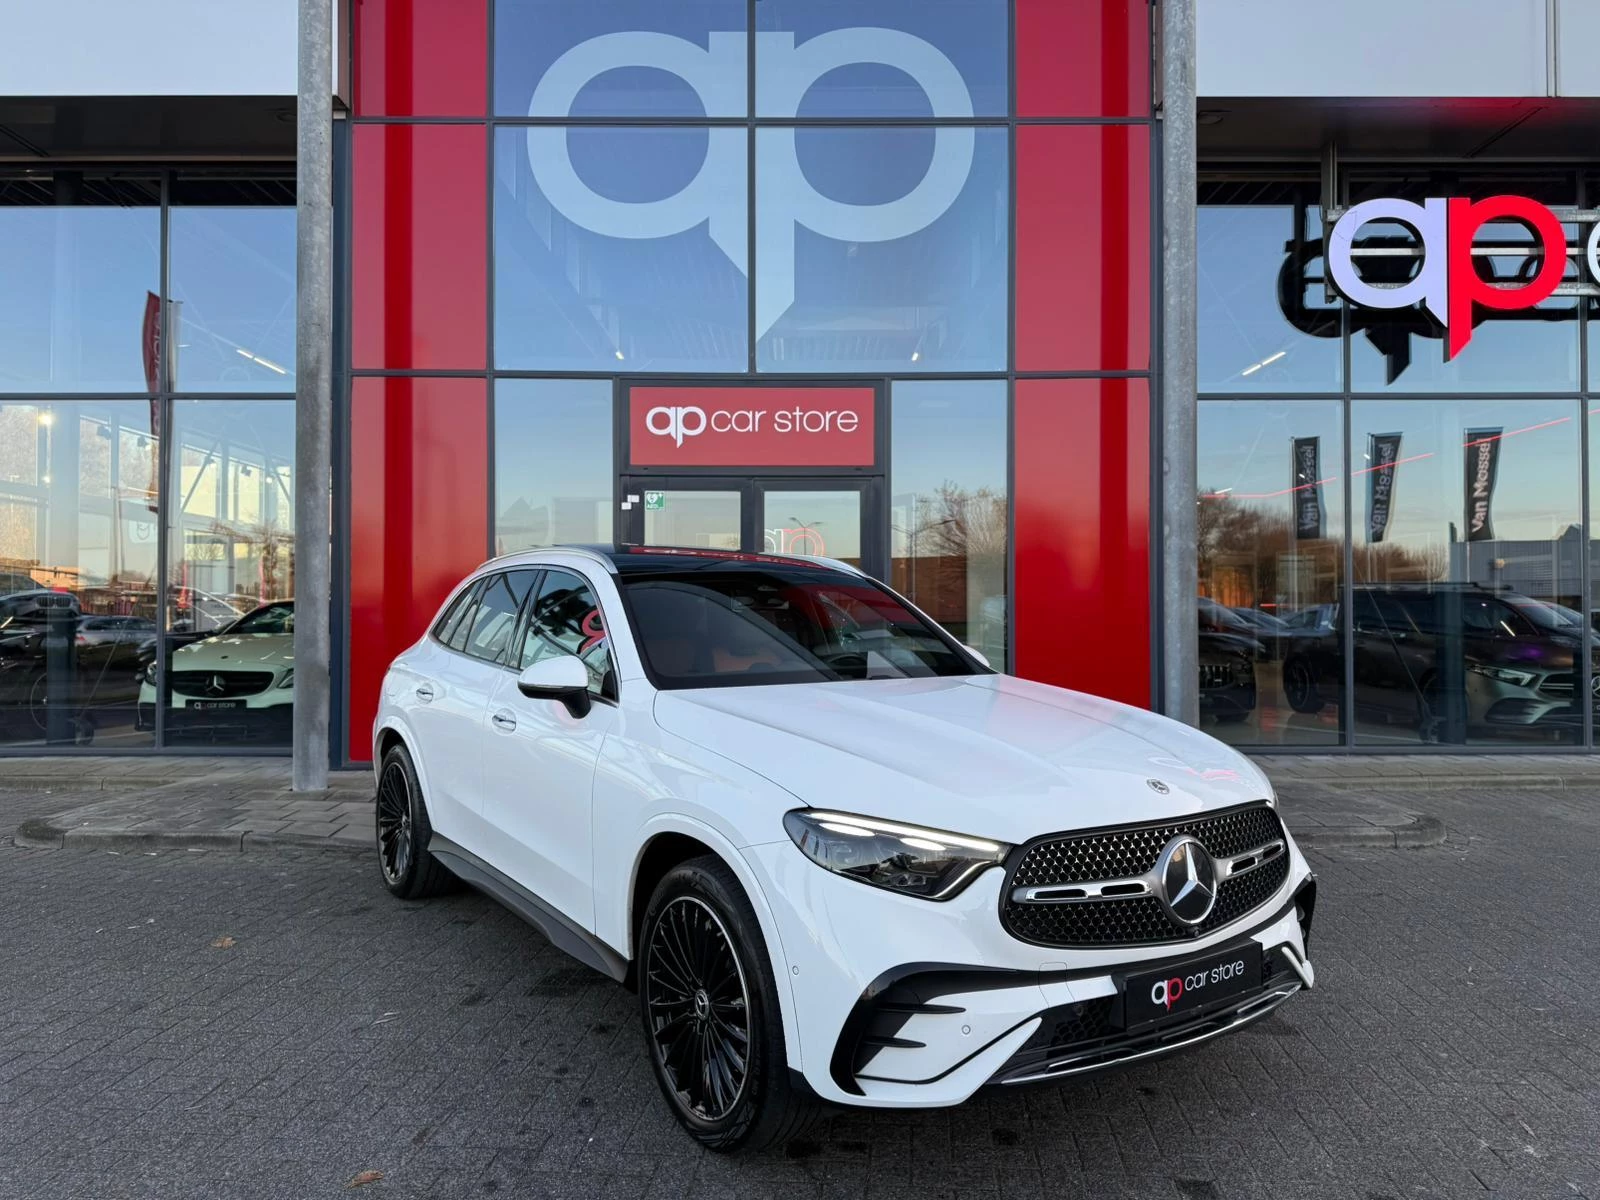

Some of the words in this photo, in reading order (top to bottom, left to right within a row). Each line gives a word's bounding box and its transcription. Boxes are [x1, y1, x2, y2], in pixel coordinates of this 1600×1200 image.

[527, 27, 975, 343] ap
[1328, 195, 1567, 362] ap
[645, 406, 707, 448] ap
[711, 409, 766, 433] car
[774, 406, 859, 433] store
[1473, 439, 1492, 498] Mossel
[1471, 501, 1488, 533] Van
[1151, 977, 1184, 1012] ap
[1185, 970, 1209, 991] car
[1211, 960, 1245, 983] store
